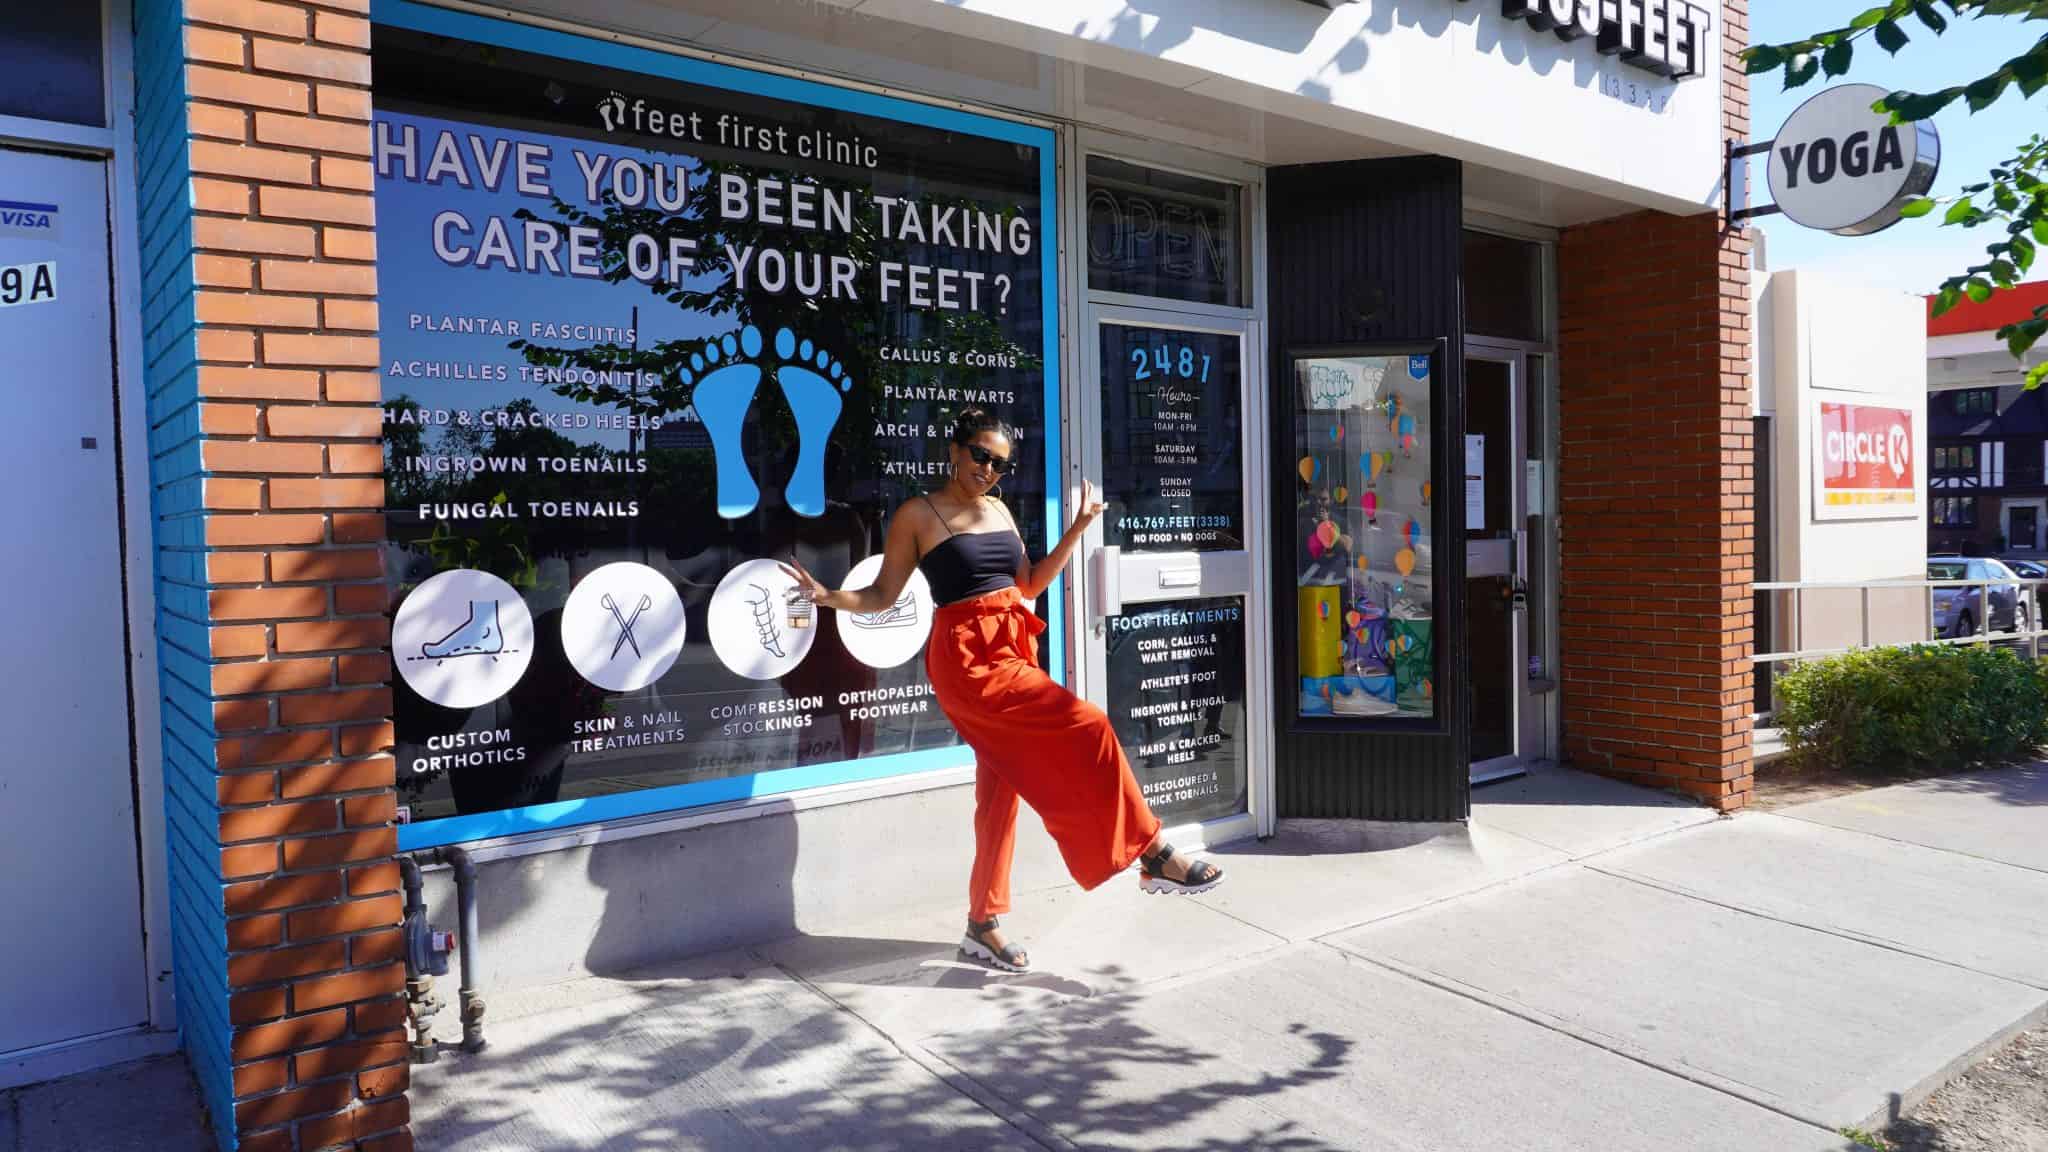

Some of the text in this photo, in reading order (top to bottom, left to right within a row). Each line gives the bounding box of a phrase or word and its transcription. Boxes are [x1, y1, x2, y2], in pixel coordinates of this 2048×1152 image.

[632, 100, 878, 168] feet first clinic
[1780, 125, 1904, 189] YOGA
[375, 121, 1032, 255] HAVE YOU BEEN TAKING
[1, 211, 51, 228] VISA
[1088, 187, 1227, 284] OPEN
[433, 210, 1012, 314] CARE OF YOUR FEET?
[409, 314, 637, 344] PLANTAR FASCIITIS
[880, 347, 1017, 368] CALLUS & CORNS
[1131, 344, 1211, 384] 2481
[1411, 359, 1427, 369] Bell
[389, 360, 655, 387] ACHILLES TENDONITIS
[884, 385, 1015, 404] PLANTAR WARTS
[382, 408, 661, 430] HARD & CRACKED HEELS
[1158, 411, 1192, 420] MON-FRI
[874, 423, 919, 437] ARCH
[927, 425, 937, 438] &
[1153, 422, 1174, 432] 10AM
[1155, 444, 1196, 454] SATURDAY
[1827, 431, 1886, 464] CIRCLE
[1888, 424, 1909, 479] K
[405, 455, 647, 473] INGROWN TOENAILS
[1159, 478, 1192, 486] SUNDAY
[1161, 488, 1191, 497] CLOSED
[419, 501, 639, 520] FUNGAL TOENAILS
[1133, 532, 1217, 543] NO FOOD NO DOGS
[1112, 608, 1239, 631] FOOT TREATMENTS
[1210, 634, 1217, 642] &
[1141, 647, 1215, 664] WART REMOVAL
[1141, 671, 1216, 690] ATHLETE'S FOOT
[711, 695, 823, 720] COMPRESSION
[850, 700, 928, 721] FOOTWEAR
[1131, 696, 1226, 718] INGROWN & FUNGAL
[574, 711, 681, 735] SKIN & NAIL
[723, 714, 813, 736] STOCKINGS
[1157, 712, 1203, 727] TOENAILS
[427, 728, 511, 751] CUSTOM
[571, 728, 686, 753] TREATMENTS
[1139, 734, 1221, 757] HARD & CRACKED
[413, 747, 526, 773] ORTHOTICS
[1167, 751, 1195, 765] HEELS
[1143, 772, 1218, 795] DISCOLOURED &
[1174, 784, 1219, 801] TOENAILS
